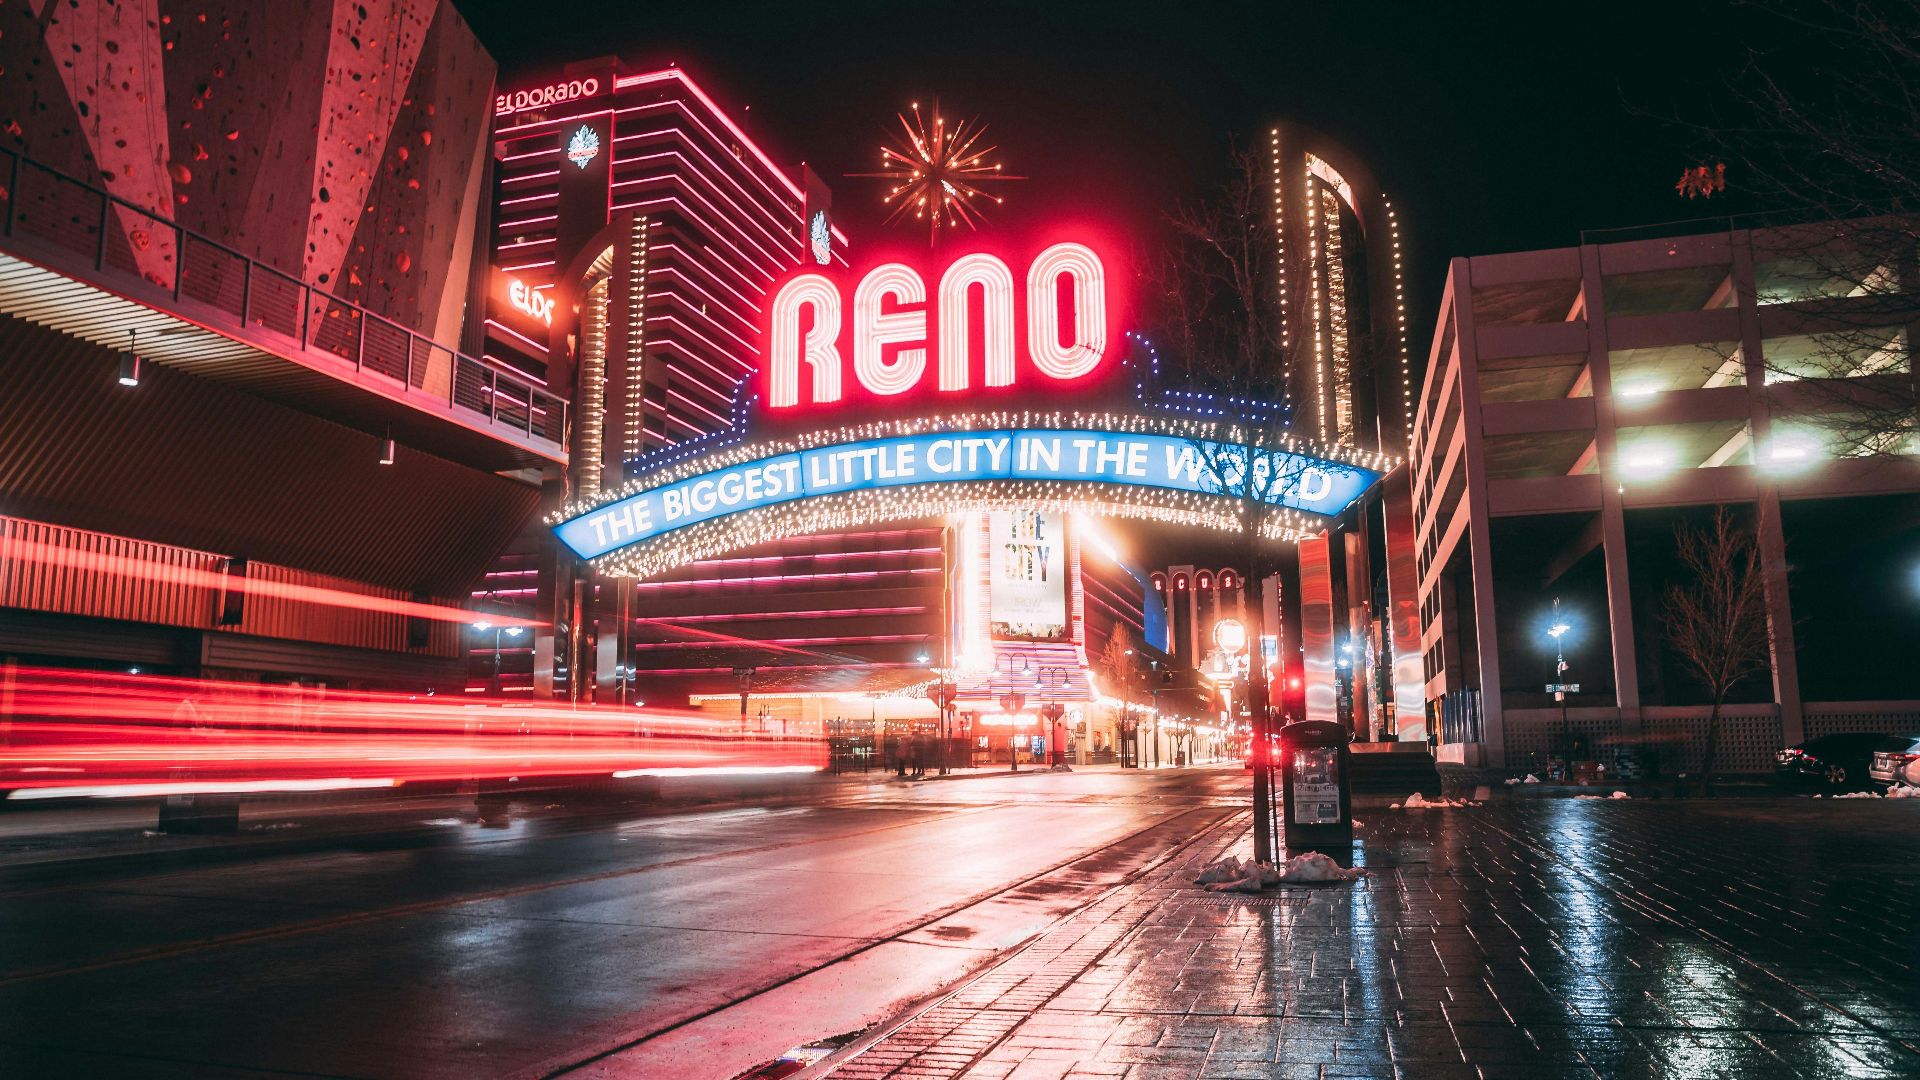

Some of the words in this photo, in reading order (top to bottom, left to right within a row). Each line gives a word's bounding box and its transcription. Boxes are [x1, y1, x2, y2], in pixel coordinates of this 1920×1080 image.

[770, 242, 1106, 408] RENO
[588, 500, 653, 547] THE
[663, 460, 800, 522] BIGGEST
[811, 444, 915, 489] LITTLE
[926, 438, 1010, 474] CITY
[1018, 438, 1061, 472] IN
[1073, 439, 1149, 477] THE
[1165, 444, 1332, 502] WORLD
